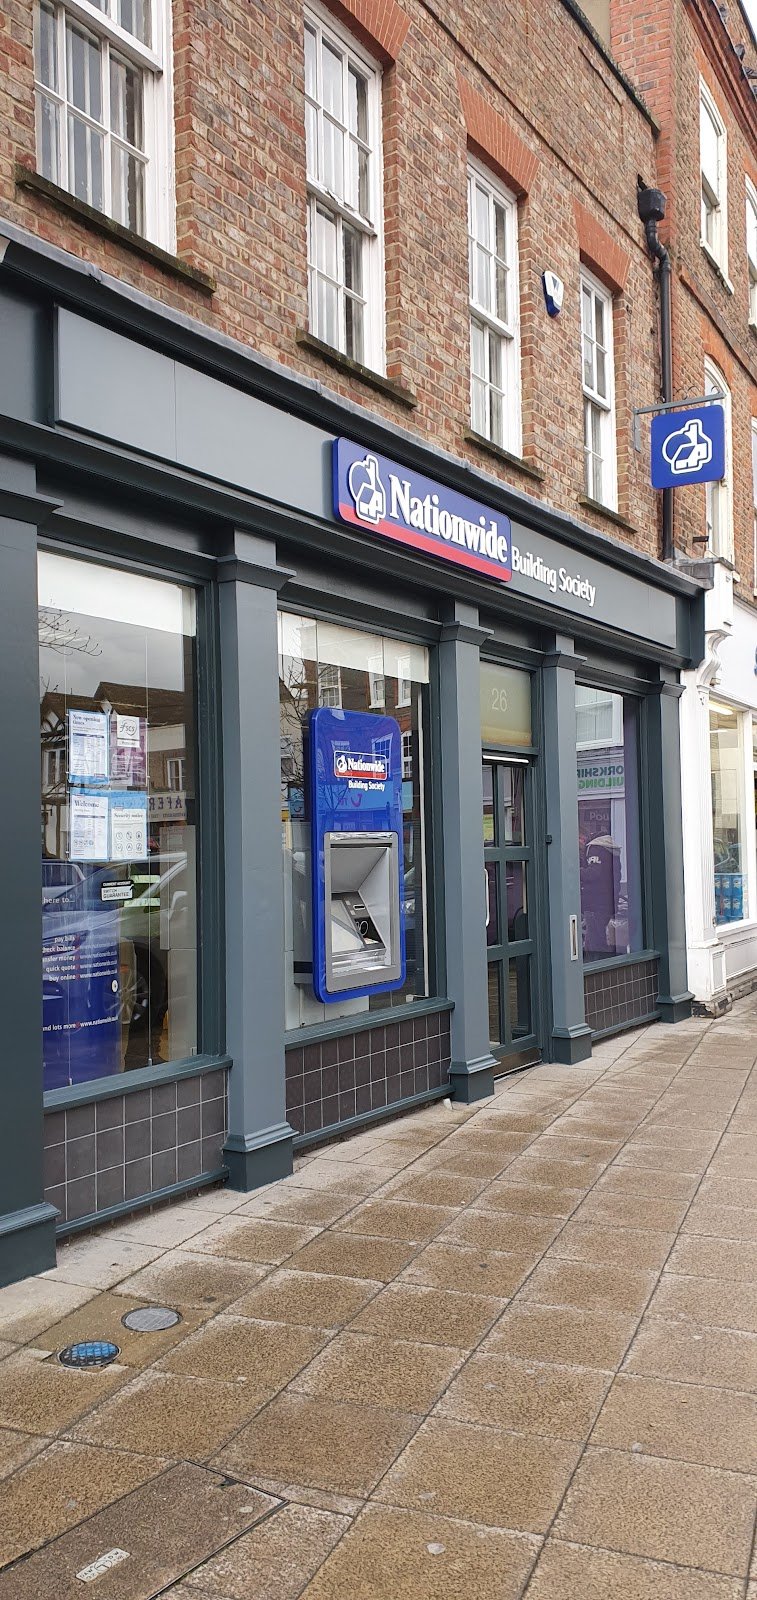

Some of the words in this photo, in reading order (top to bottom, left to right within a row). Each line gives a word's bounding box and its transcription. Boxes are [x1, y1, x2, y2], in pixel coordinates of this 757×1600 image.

[389, 474, 508, 563] Nationwide
[511, 546, 557, 592] Building
[558, 568, 597, 607] Society
[491, 687, 508, 712] 26
[347, 757, 385, 772] Nationwide
[348, 780, 369, 791] Building
[368, 781, 386, 792] Society
[74, 799, 99, 808] Welcome
[46, 965, 60, 973] quick
[60, 964, 76, 972] quote
[49, 975, 60, 983] buy
